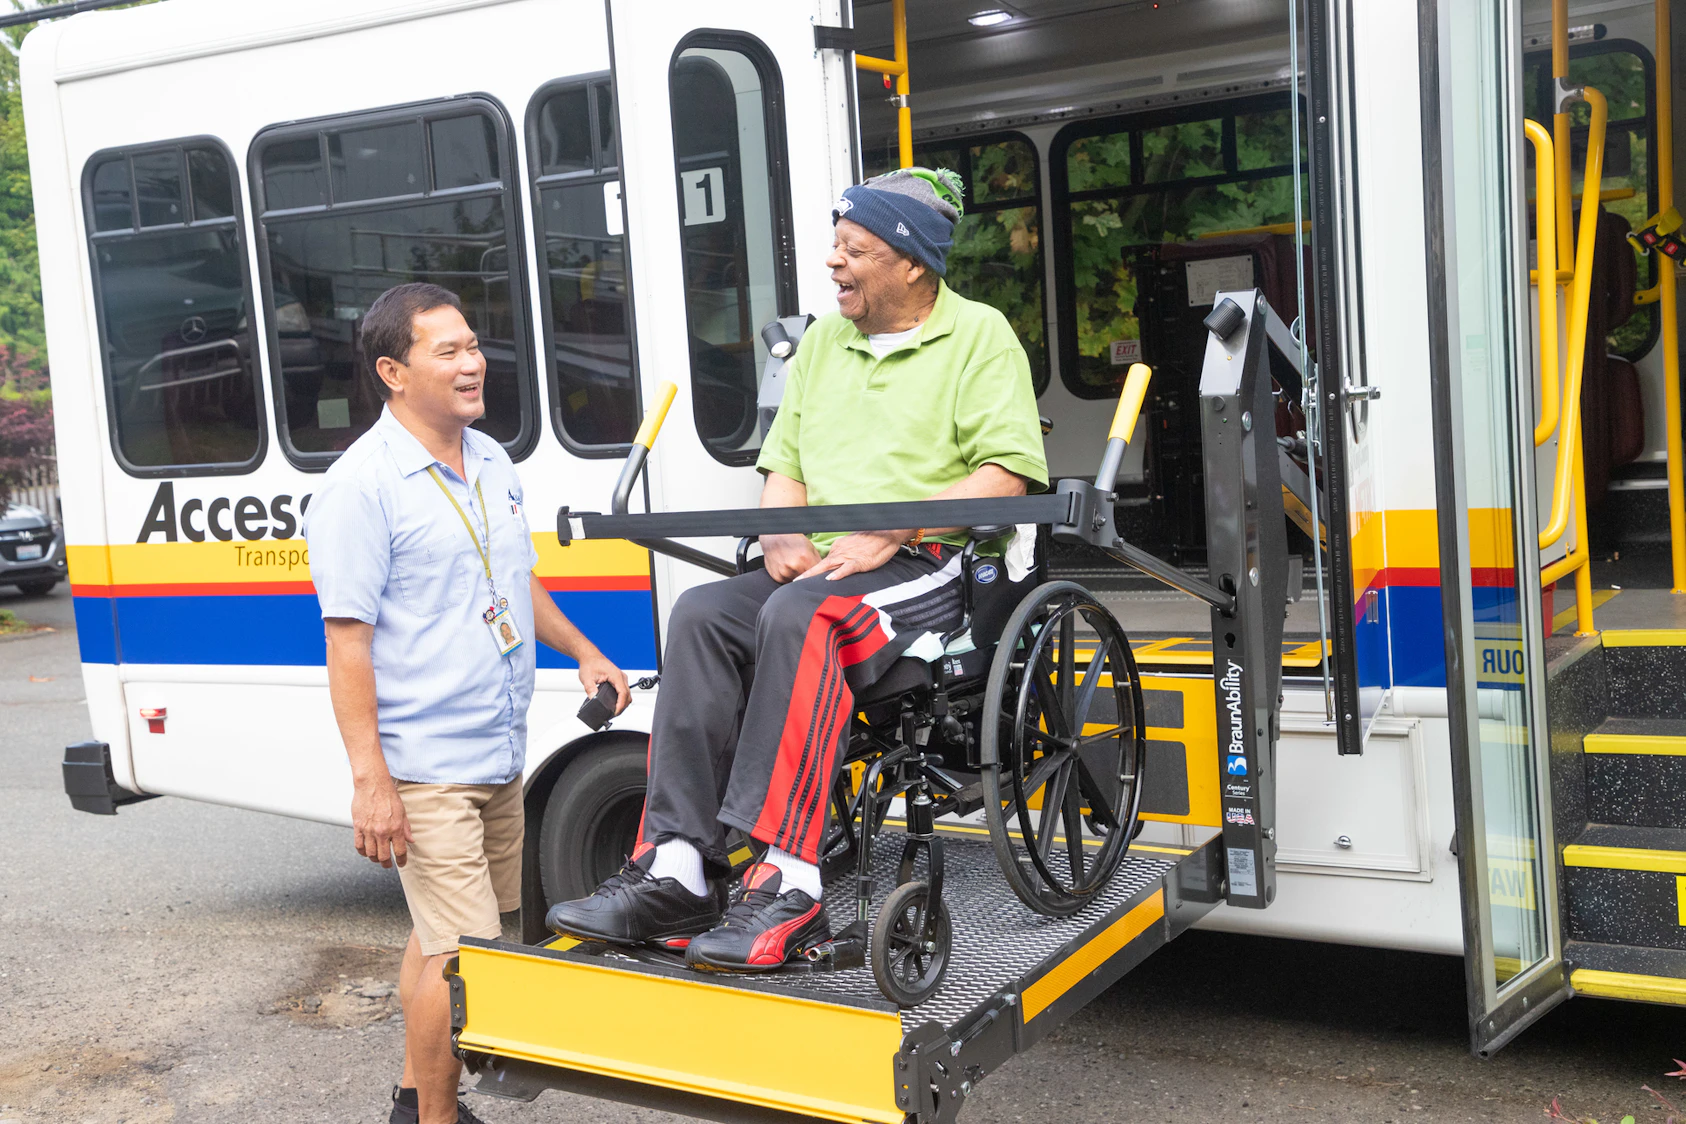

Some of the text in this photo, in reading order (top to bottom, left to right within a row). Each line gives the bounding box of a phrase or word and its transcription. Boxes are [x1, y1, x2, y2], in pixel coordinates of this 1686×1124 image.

[1116, 344, 1136, 355] EXIT
[136, 481, 313, 543] Acces
[1220, 660, 1244, 754] BraunAbility
[1227, 784, 1250, 793] Century
[1226, 812, 1255, 825] USA
